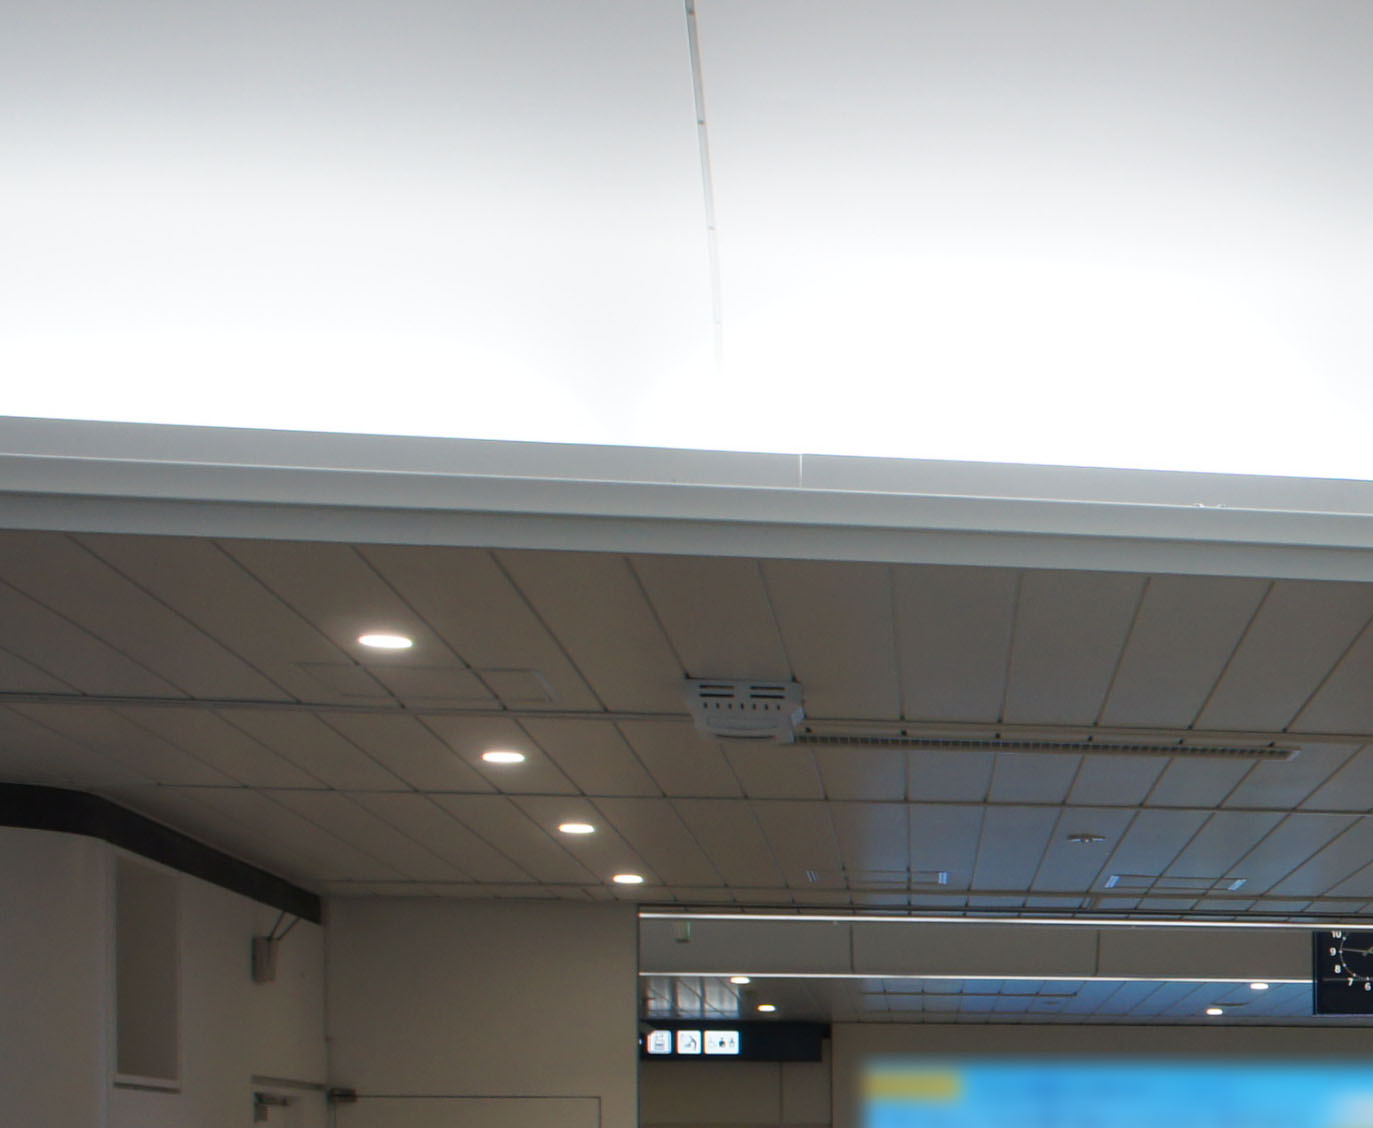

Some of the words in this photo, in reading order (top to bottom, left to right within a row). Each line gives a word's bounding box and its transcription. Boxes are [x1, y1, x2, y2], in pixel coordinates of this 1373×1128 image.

[1329, 947, 1337, 956] 9
[1334, 964, 1341, 974] 8
[1346, 976, 1354, 987] 7
[1364, 982, 1372, 992] 6
